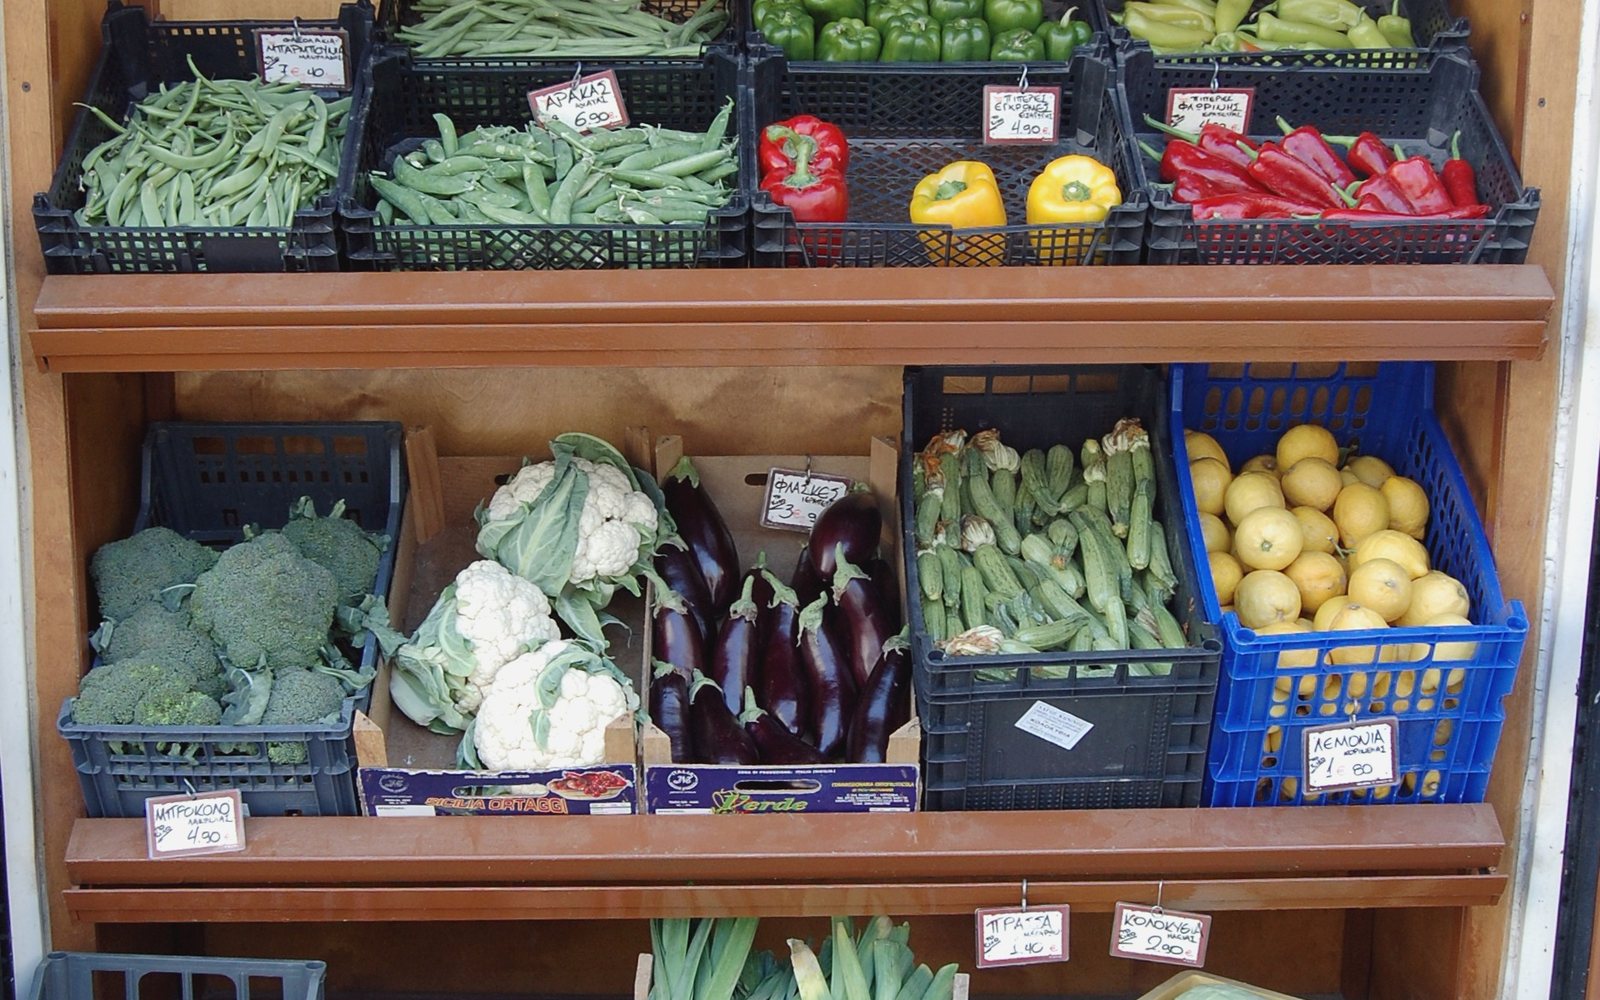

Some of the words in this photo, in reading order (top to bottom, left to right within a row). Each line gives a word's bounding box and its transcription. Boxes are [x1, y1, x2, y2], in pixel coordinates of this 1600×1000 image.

[306, 66, 325, 78] 40
[545, 80, 611, 111] ΑΡΑΚΑΣ
[574, 111, 610, 127] 6.90
[1011, 120, 1041, 135] 4.90
[778, 503, 794, 519] 3
[1313, 729, 1385, 753] ΛΕΜΟΝΙΑ
[1352, 763, 1374, 776] 80
[424, 797, 487, 811] SICILIA
[488, 797, 570, 815] ORTAGGI
[718, 789, 809, 812] Verde
[186, 825, 221, 844] 4.90
[1144, 935, 1185, 955] 2.90
